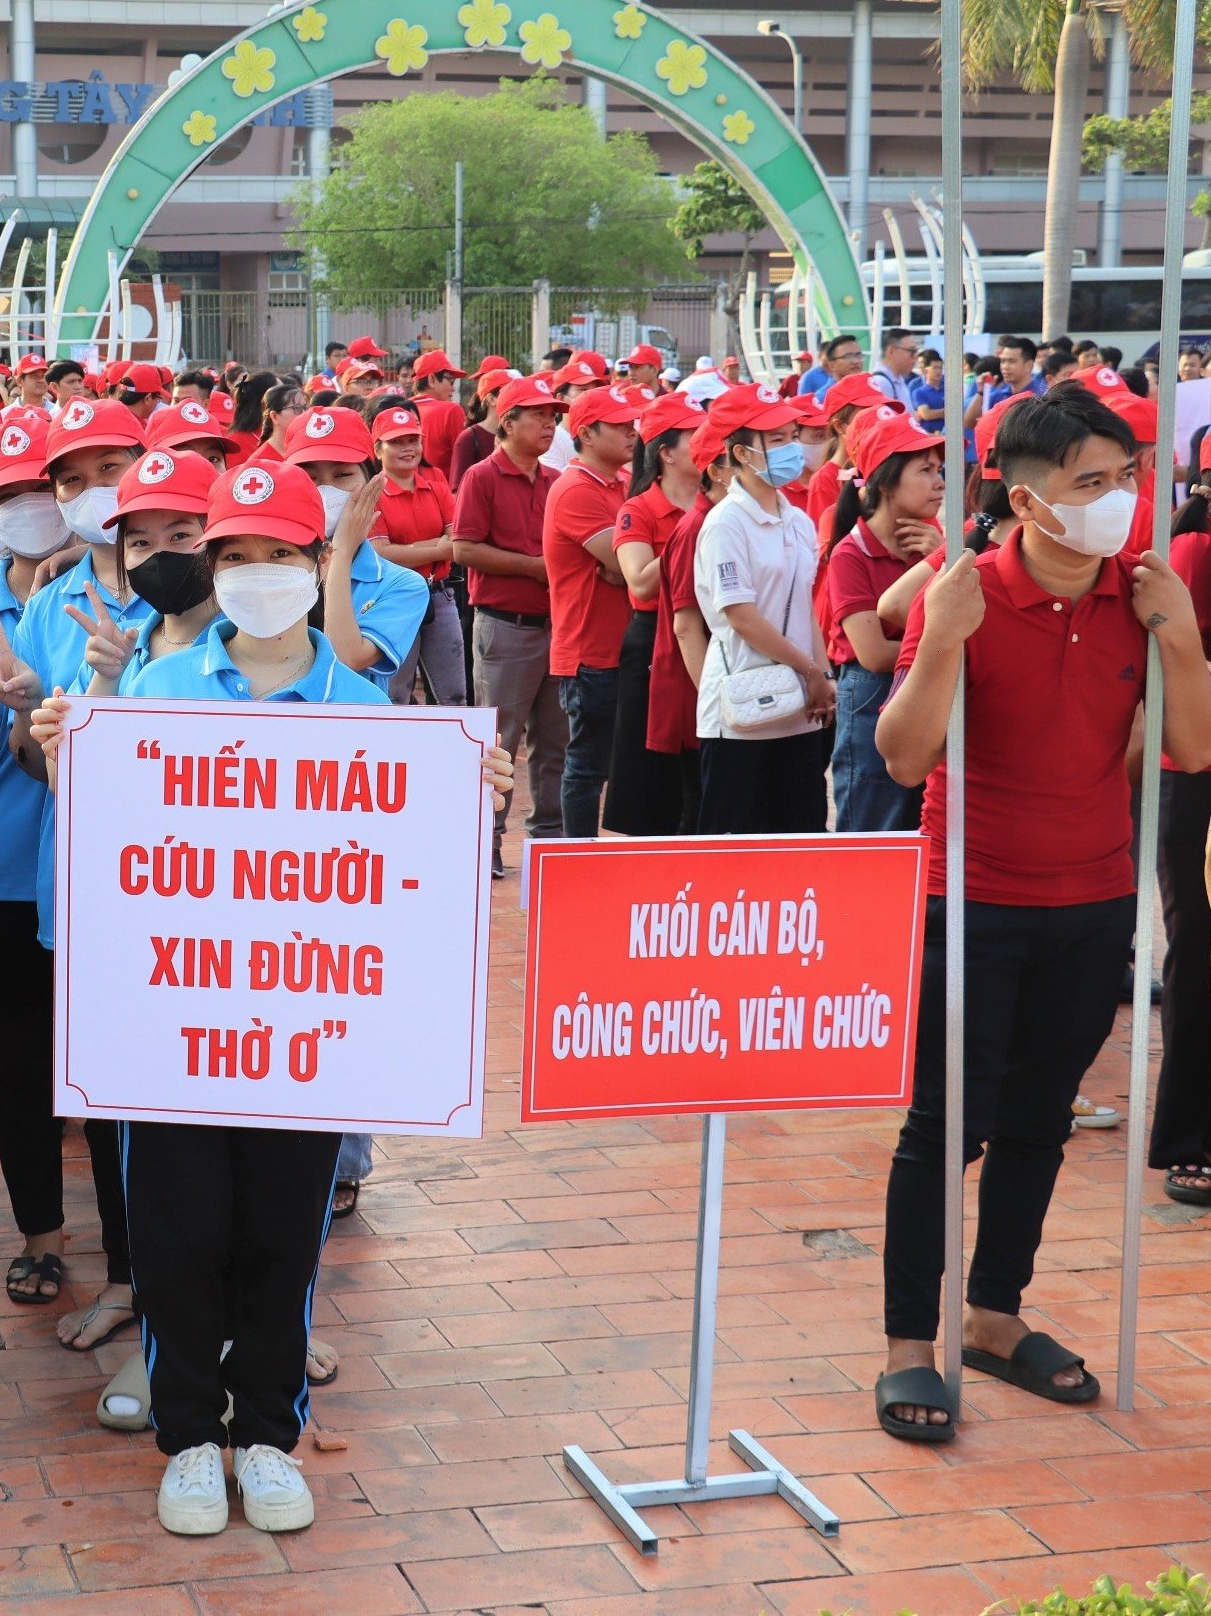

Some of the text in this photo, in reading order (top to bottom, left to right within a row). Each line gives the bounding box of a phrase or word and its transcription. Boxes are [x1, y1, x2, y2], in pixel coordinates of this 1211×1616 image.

[46, 69, 153, 124] TÂY
[621, 514, 632, 531] 3
[295, 750, 407, 813] MÁU
[119, 836, 215, 898] CỨU
[233, 840, 384, 905] NGƯỜI
[628, 882, 824, 967] KHỐI CÁN BỘ,
[149, 931, 384, 996] XIN ĐỪNG
[181, 1018, 273, 1080] THỜ
[551, 982, 892, 1061] CÔNG CHỨC, VIÊN CHỨC
